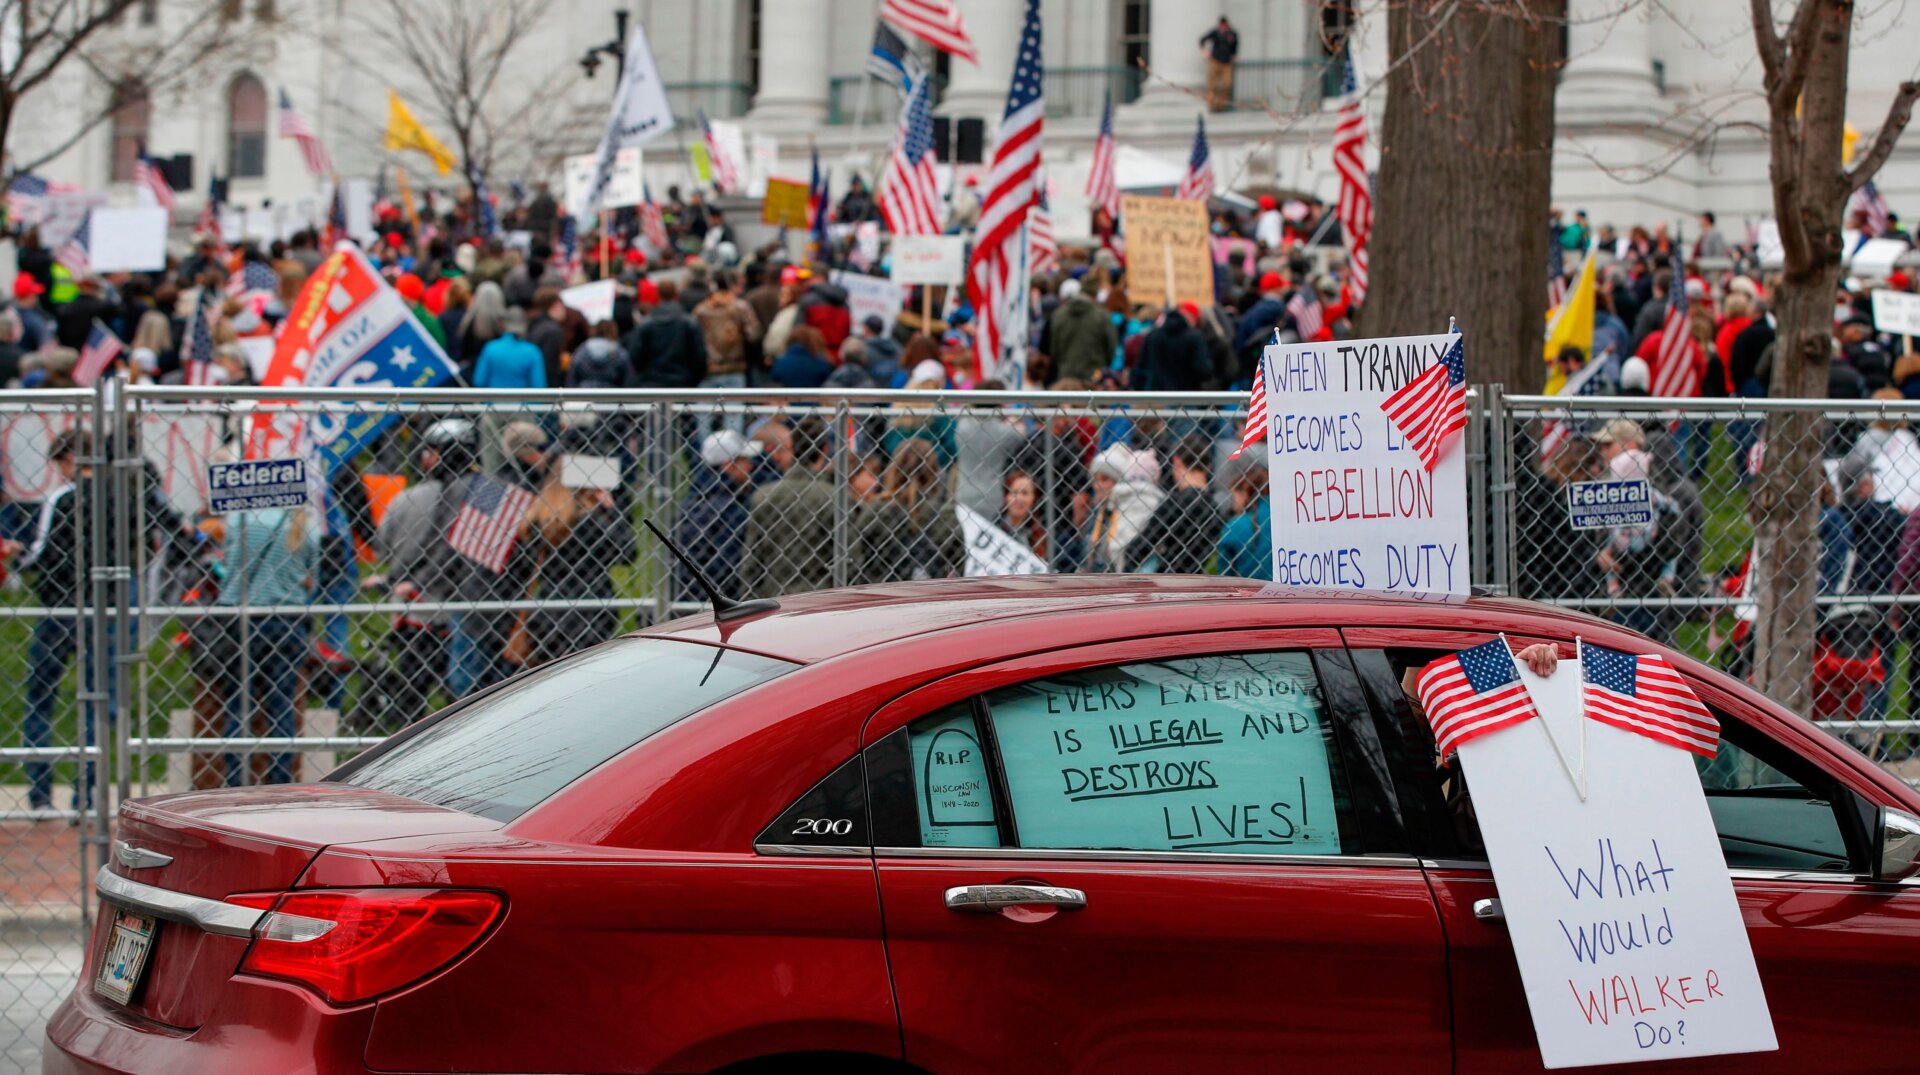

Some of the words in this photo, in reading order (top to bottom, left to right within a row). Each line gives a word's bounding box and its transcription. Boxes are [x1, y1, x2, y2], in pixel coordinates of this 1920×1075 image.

[1268, 351, 1327, 393] WHEN
[1274, 412, 1363, 454] BECOMES
[212, 461, 303, 488] Federal
[1572, 482, 1646, 505] Federal
[1294, 467, 1433, 523] REBELLION
[1277, 548, 1365, 588] BECOMES
[1386, 543, 1457, 590] DUTY
[1047, 680, 1139, 714] EVERS'
[1160, 677, 1310, 706] EXTENSION
[1054, 729, 1082, 754] IS
[1110, 718, 1223, 748] ILLEGAL
[1241, 712, 1310, 740] AND
[935, 750, 970, 765] R.I.P.
[1062, 760, 1217, 794] DESTROYS
[932, 780, 980, 793] WISCONSIN
[792, 818, 853, 835] 200
[1163, 776, 1310, 840] LIVES!
[1569, 969, 1724, 1025] WALKER
